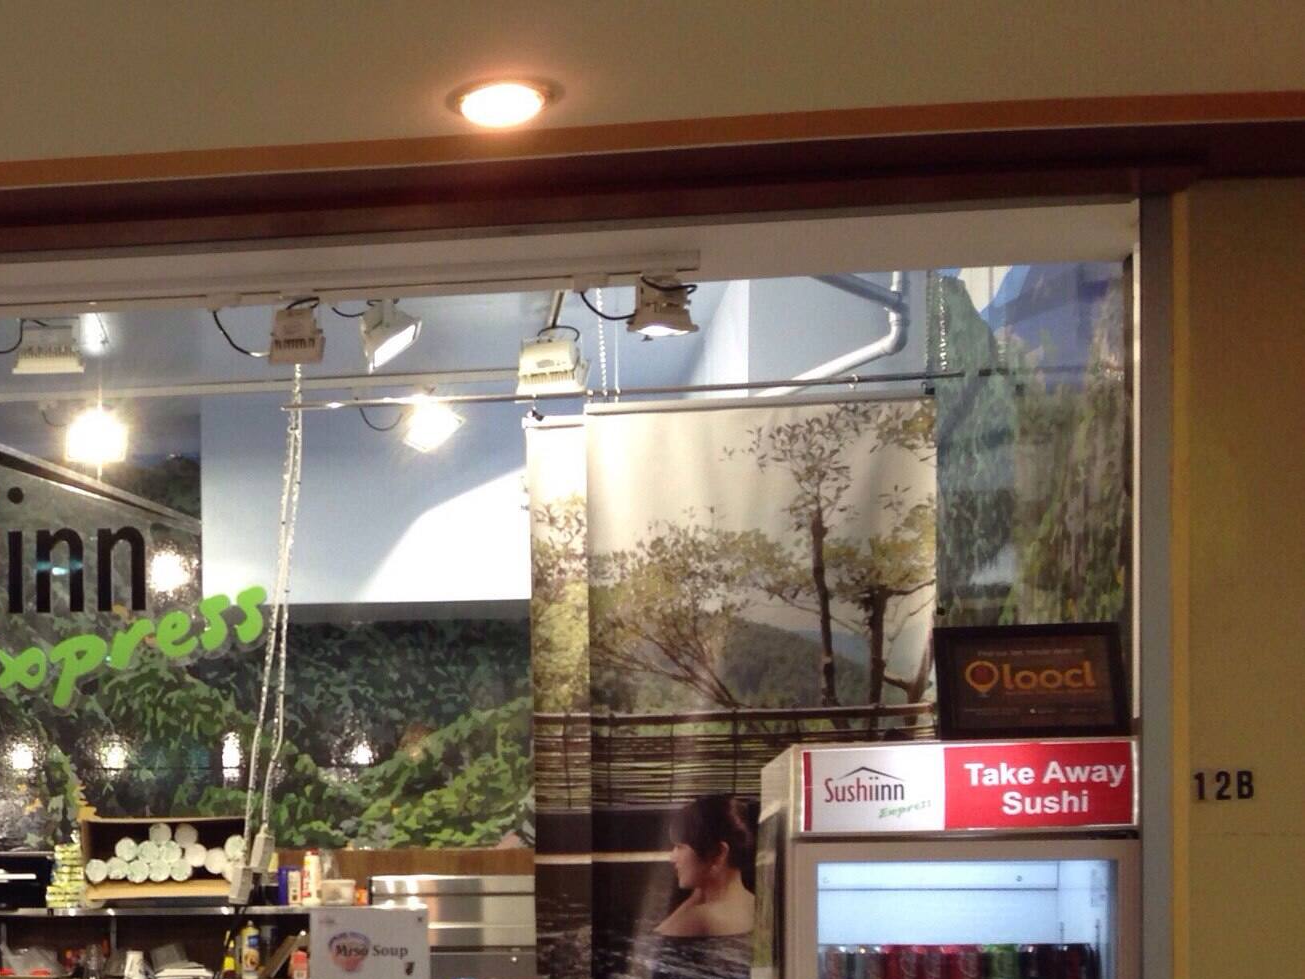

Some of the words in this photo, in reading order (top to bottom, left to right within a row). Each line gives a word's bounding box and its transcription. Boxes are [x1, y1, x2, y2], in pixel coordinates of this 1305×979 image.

[964, 762, 1035, 786] Take
[1043, 761, 1126, 787] Away
[1194, 770, 1254, 800] 12B
[1002, 790, 1089, 815] Sushi
[335, 944, 369, 957] Miso
[372, 944, 408, 960] Soup
